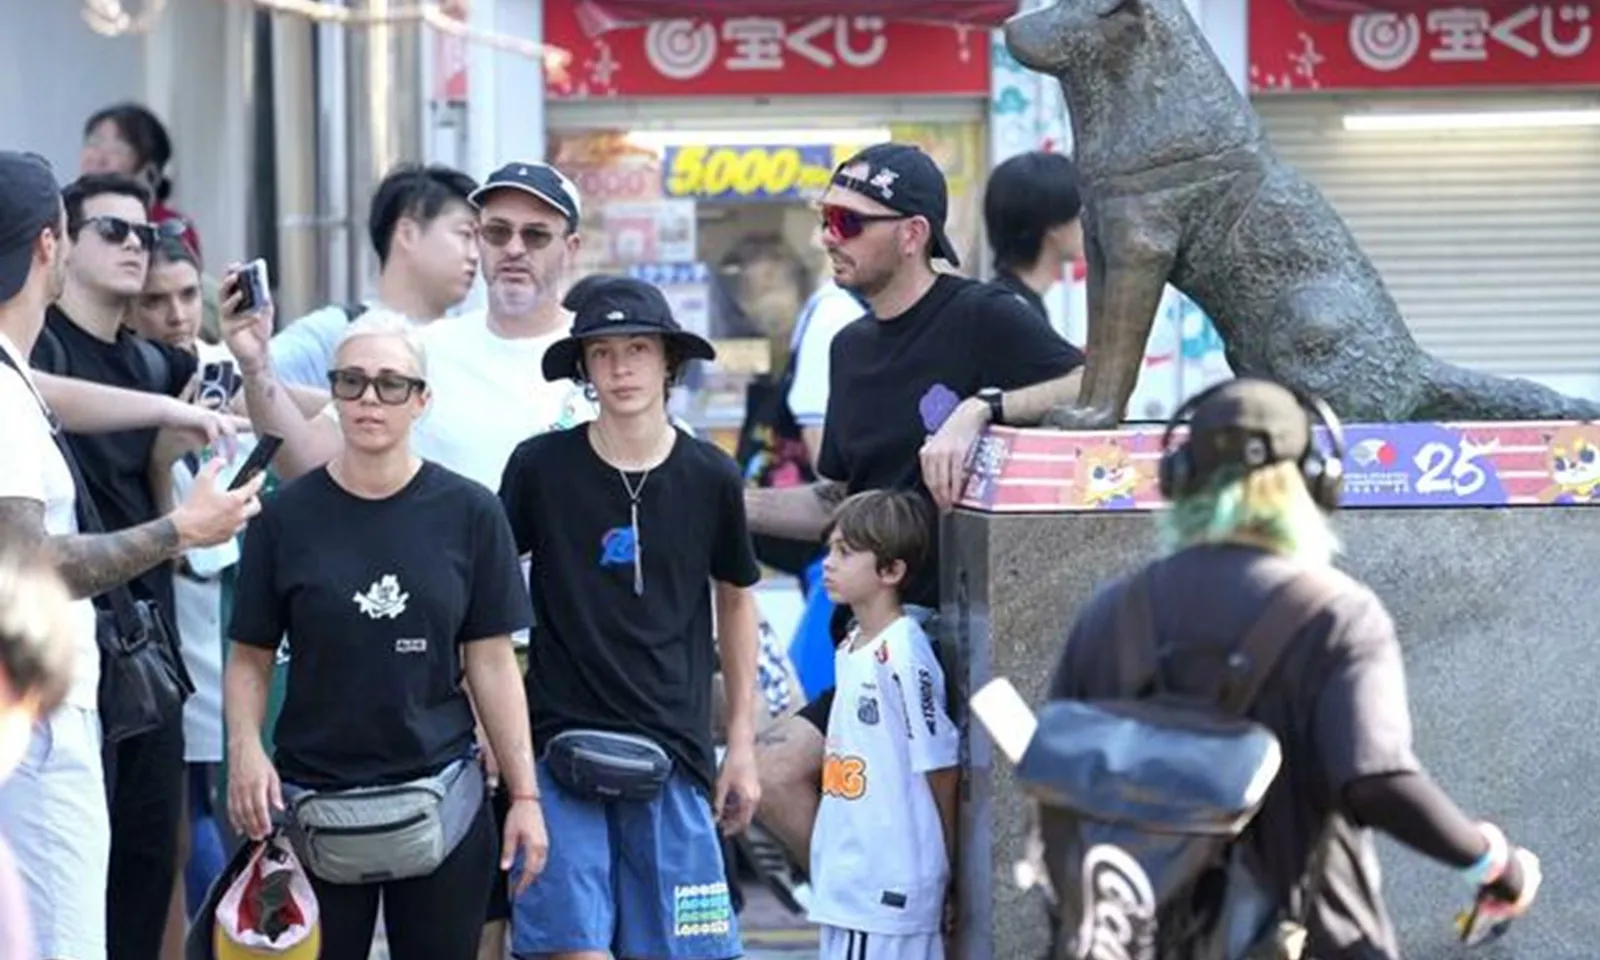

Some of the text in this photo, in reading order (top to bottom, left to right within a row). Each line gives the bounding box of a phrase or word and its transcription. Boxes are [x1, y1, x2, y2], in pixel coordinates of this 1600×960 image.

[721, 16, 887, 70] 宝くじ
[1427, 5, 1592, 61] 宝くじ
[1412, 434, 1499, 496] 25
